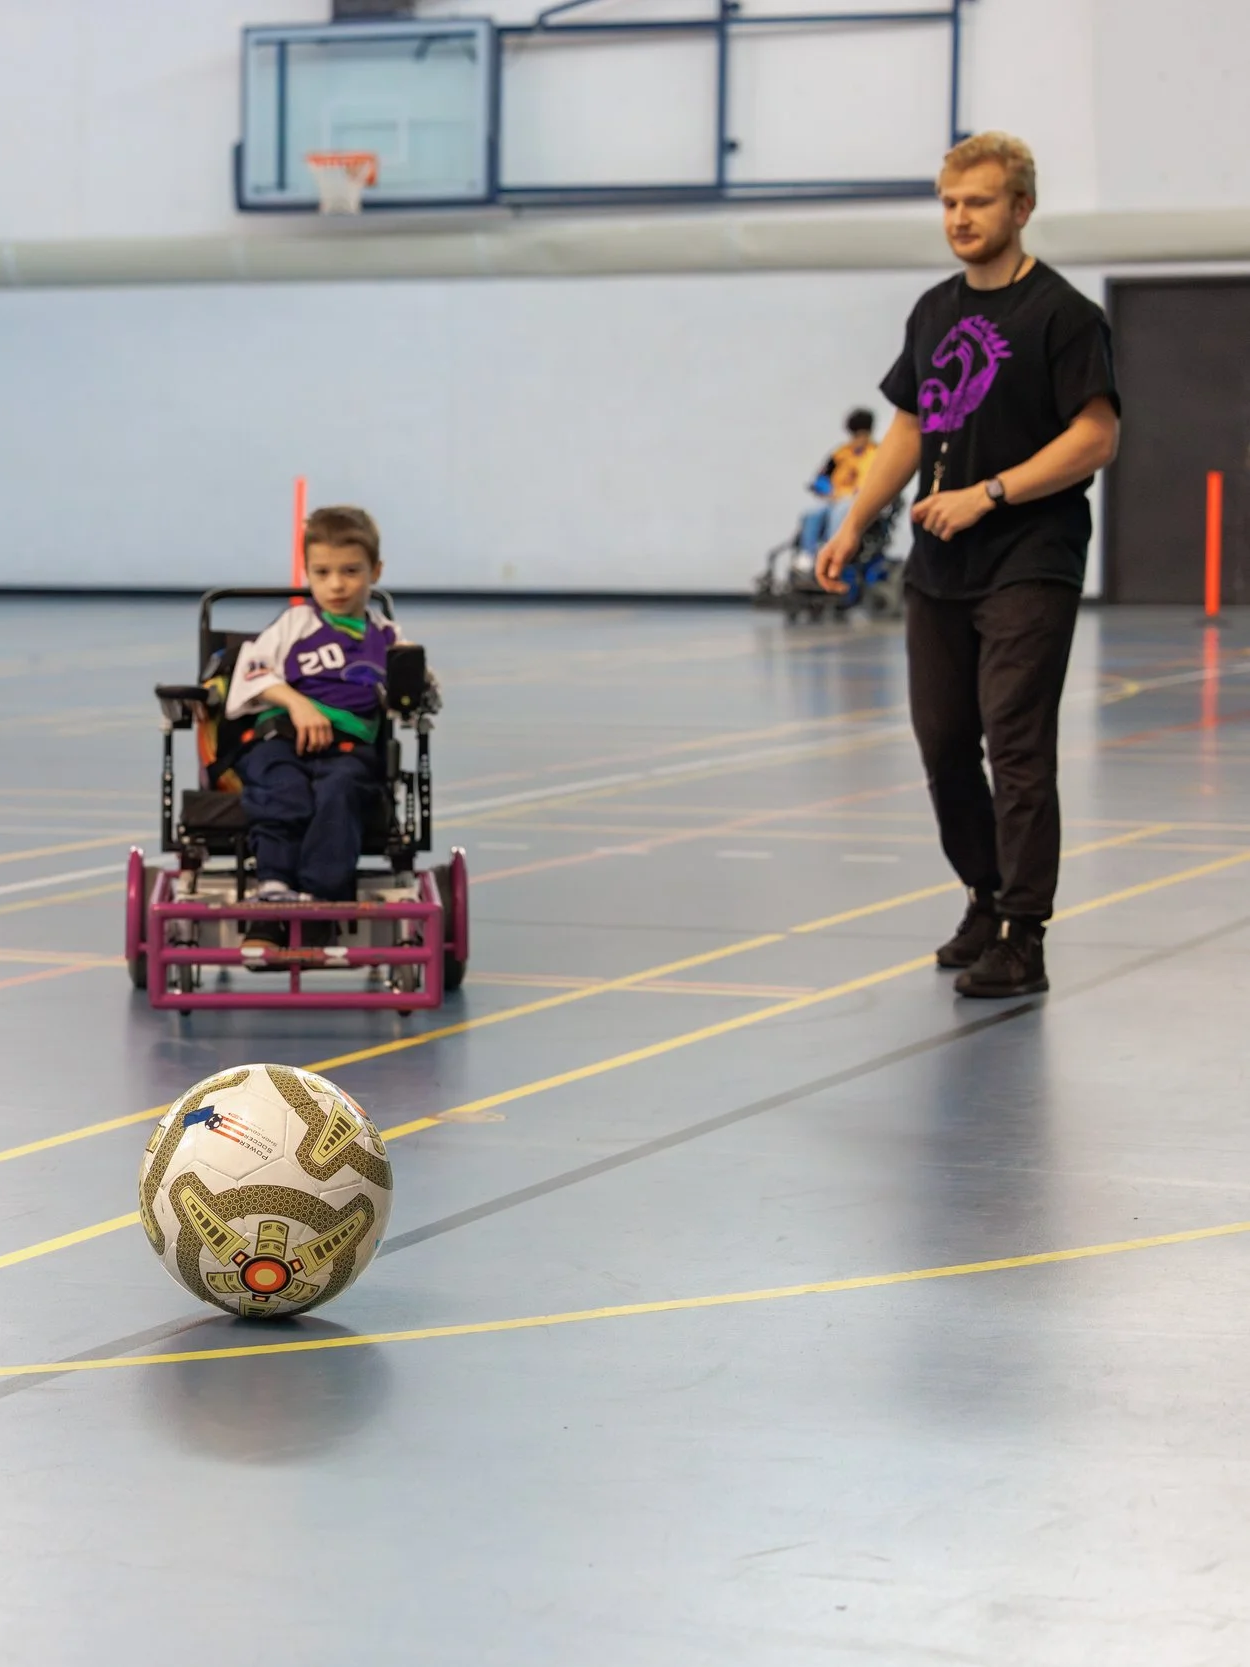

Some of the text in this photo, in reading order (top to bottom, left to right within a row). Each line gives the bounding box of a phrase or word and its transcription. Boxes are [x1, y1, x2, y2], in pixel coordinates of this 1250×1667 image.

[297, 642, 346, 676] 20
[239, 1139, 269, 1161] POWER
[243, 1134, 274, 1154] SOCCER
